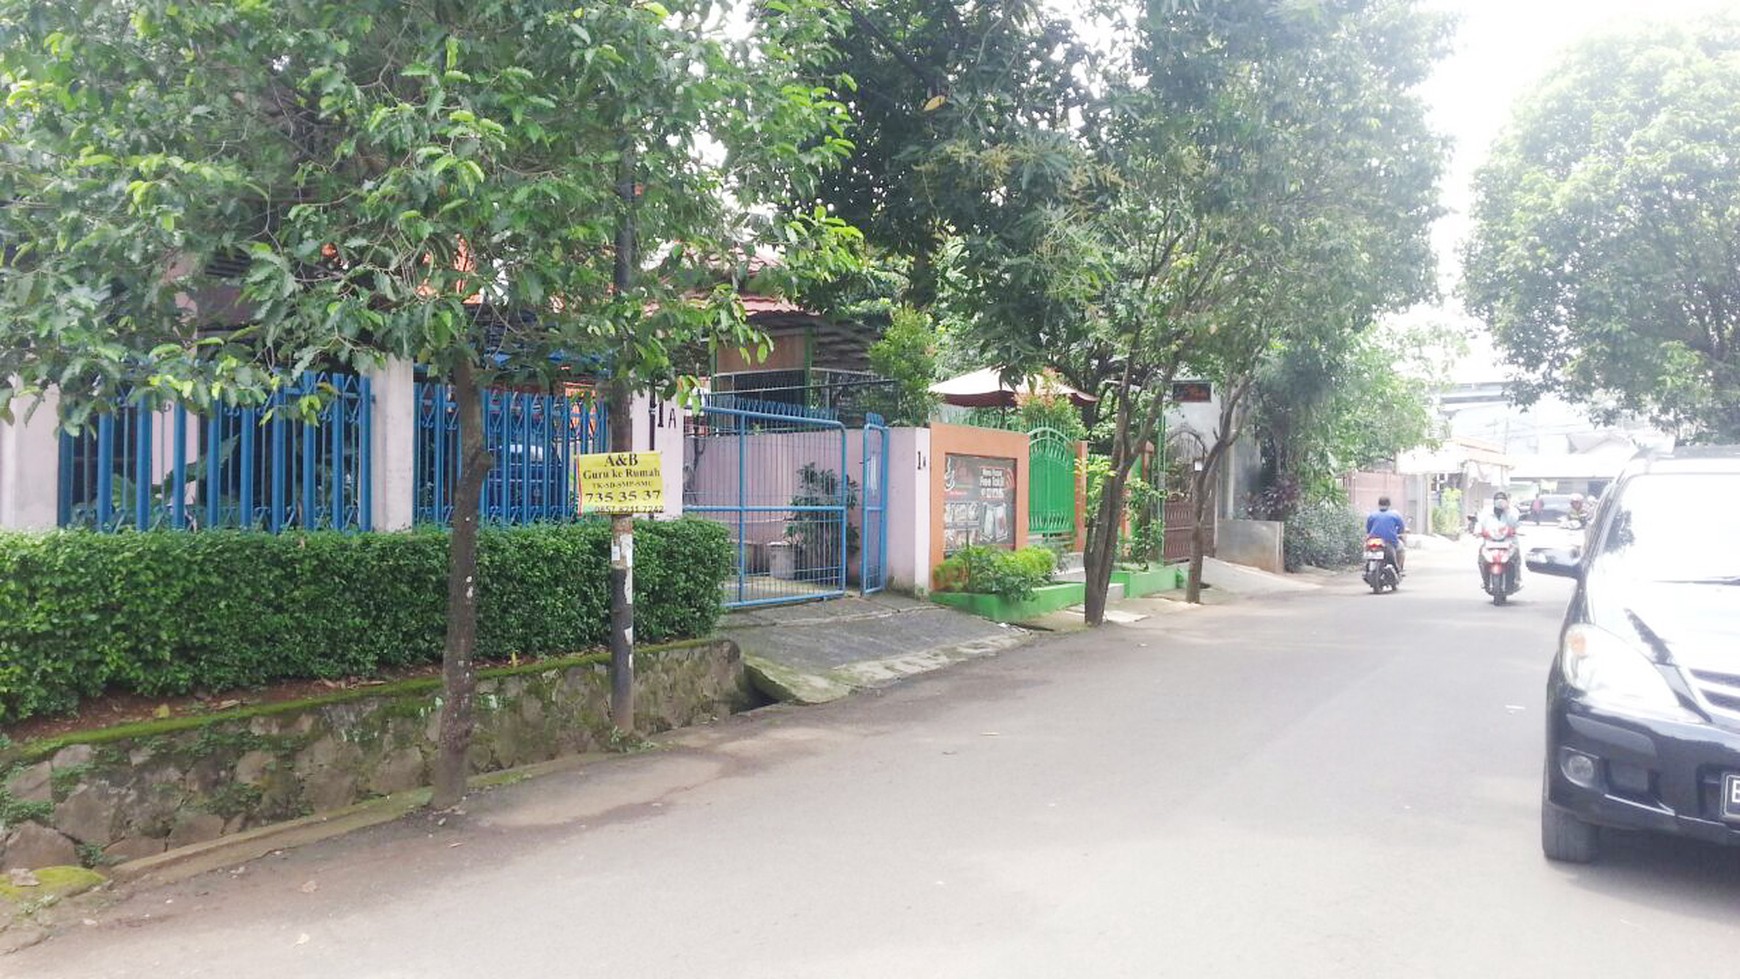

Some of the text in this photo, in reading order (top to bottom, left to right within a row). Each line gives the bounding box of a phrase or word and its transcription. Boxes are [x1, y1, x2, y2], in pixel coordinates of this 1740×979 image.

[604, 453, 638, 467] A&B
[583, 468, 660, 479] Guru ke Rumah
[585, 490, 661, 502] 735 35 37
